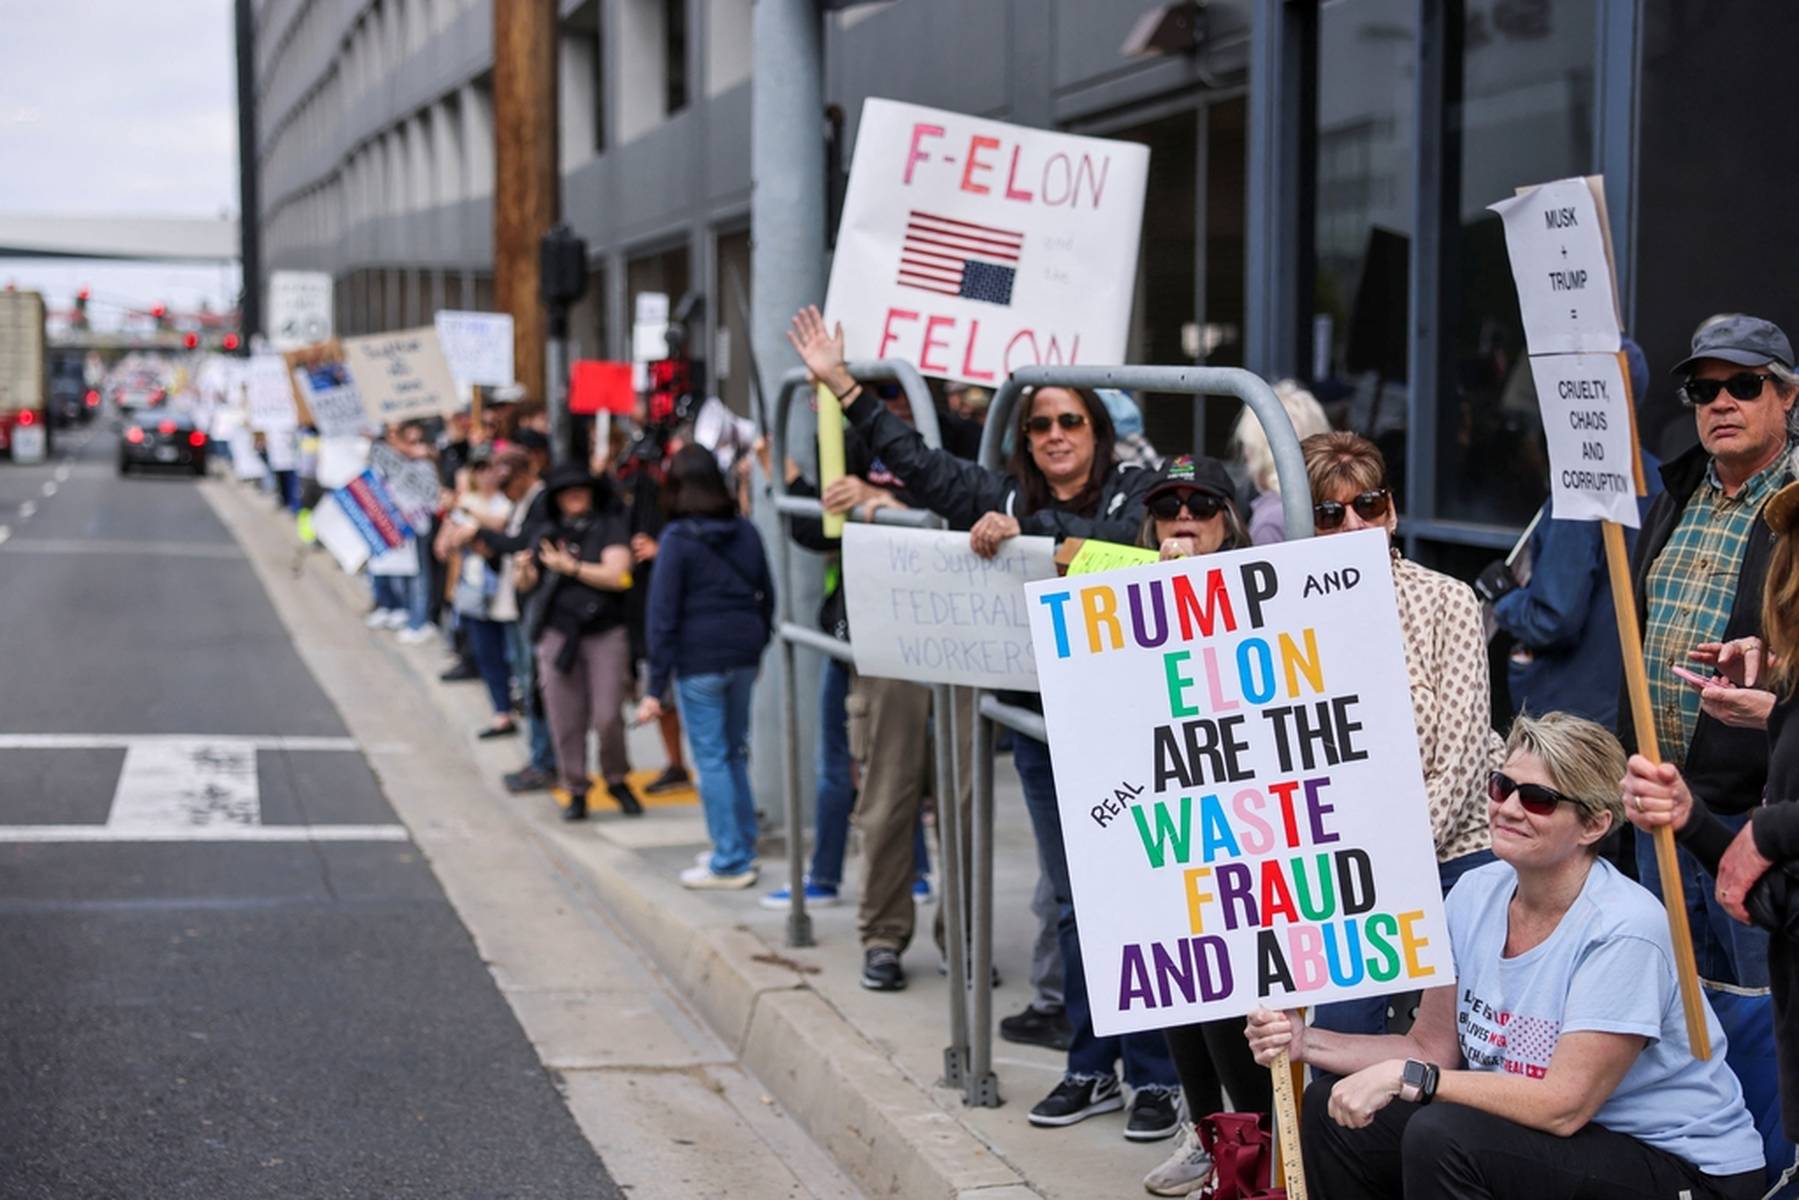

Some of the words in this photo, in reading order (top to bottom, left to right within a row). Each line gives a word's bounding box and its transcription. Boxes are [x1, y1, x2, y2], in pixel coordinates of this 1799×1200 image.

[903, 123, 1109, 208] F-ELON
[1545, 207, 1578, 230] MUSK
[1549, 270, 1588, 292] TRUMP
[1558, 380, 1610, 402] CRUELTY,
[1570, 410, 1608, 431] CHAOS
[1582, 442, 1605, 462] AND
[1562, 470, 1628, 495] CORRUPTION
[888, 536, 921, 574] We
[932, 537, 1029, 587] Support
[891, 588, 1030, 628] FEDERAL
[1040, 560, 1279, 658] TRUMP
[1303, 568, 1360, 598] AND
[1163, 627, 1325, 718] ELON
[1154, 714, 1255, 793] ARE
[1262, 694, 1368, 773] THE
[1091, 781, 1144, 828] REAL
[1131, 777, 1340, 869] WASTE
[1183, 848, 1377, 935] FRAUD
[1118, 935, 1234, 1012] AND
[1257, 910, 1436, 998] ABUSE
